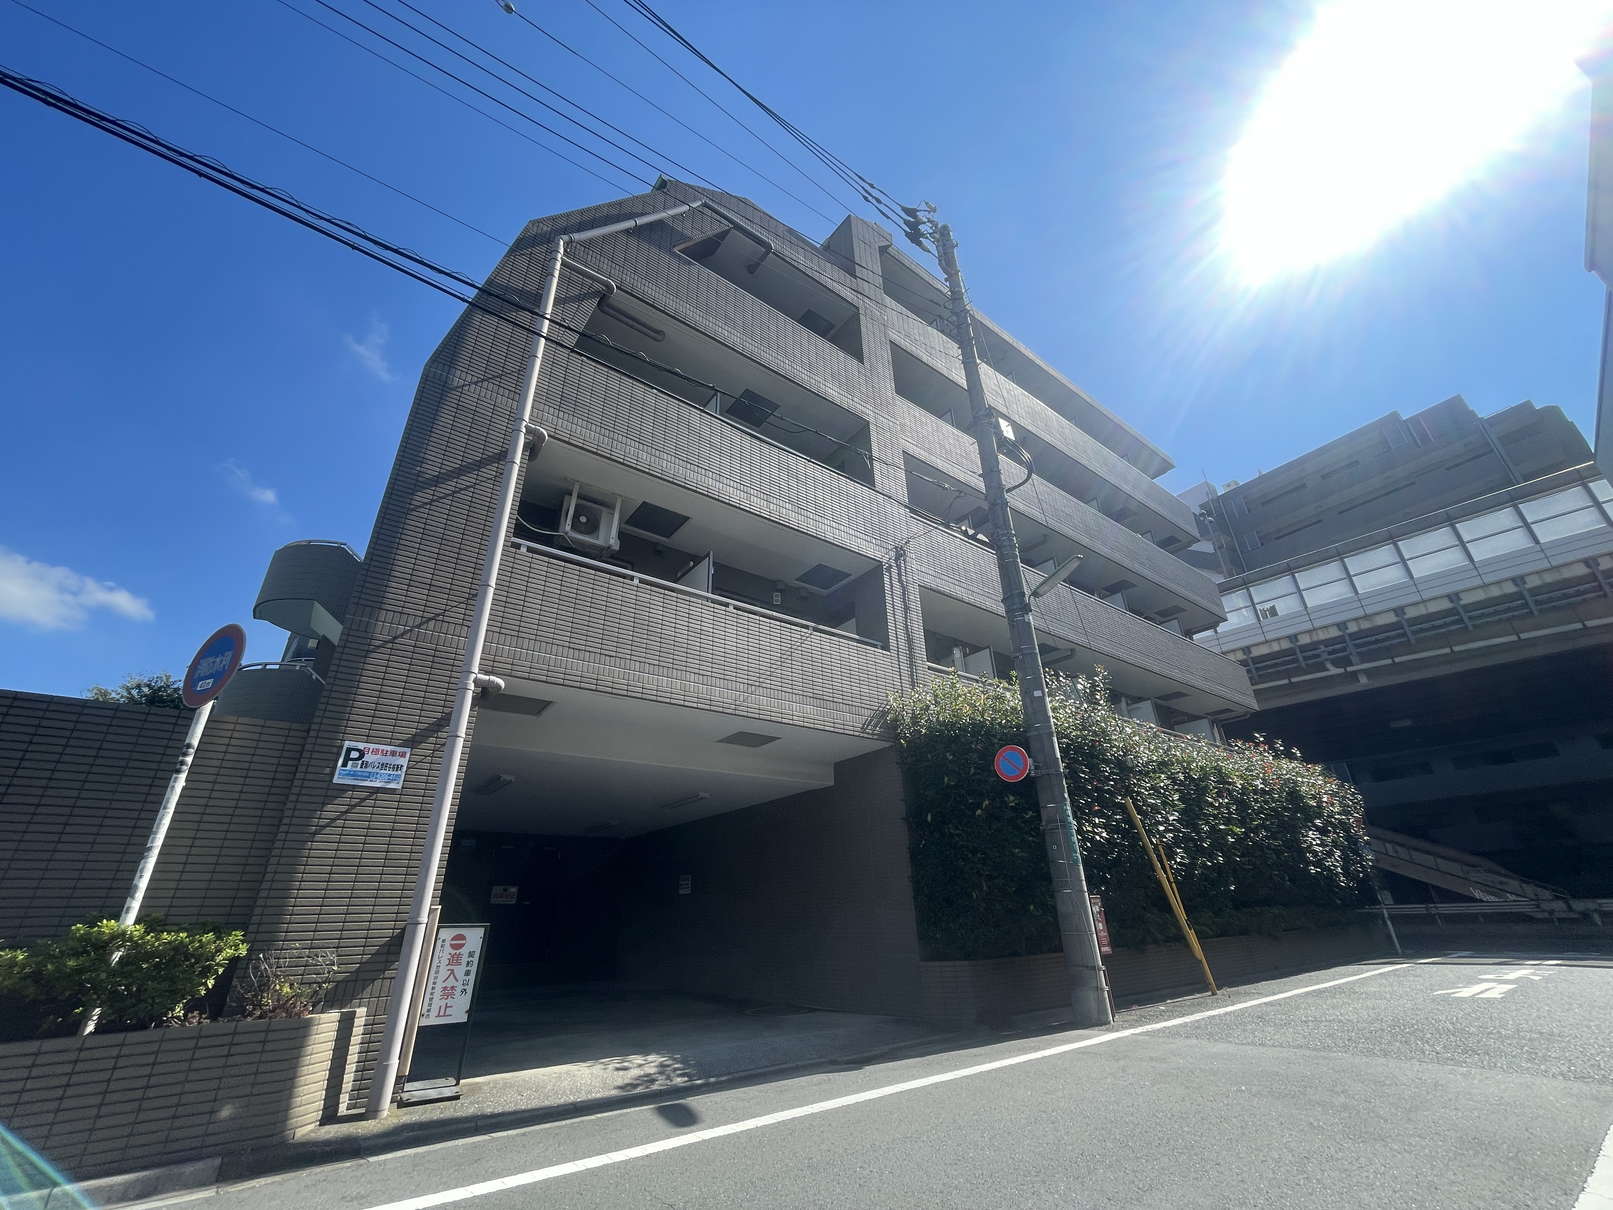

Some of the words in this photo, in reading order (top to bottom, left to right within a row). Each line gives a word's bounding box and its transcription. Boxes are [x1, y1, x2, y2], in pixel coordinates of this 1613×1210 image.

[341, 747, 366, 768] P
[363, 747, 407, 759] 月極駐車場
[435, 951, 463, 1018] 進入禁止
[459, 950, 476, 997] 契約車以外
